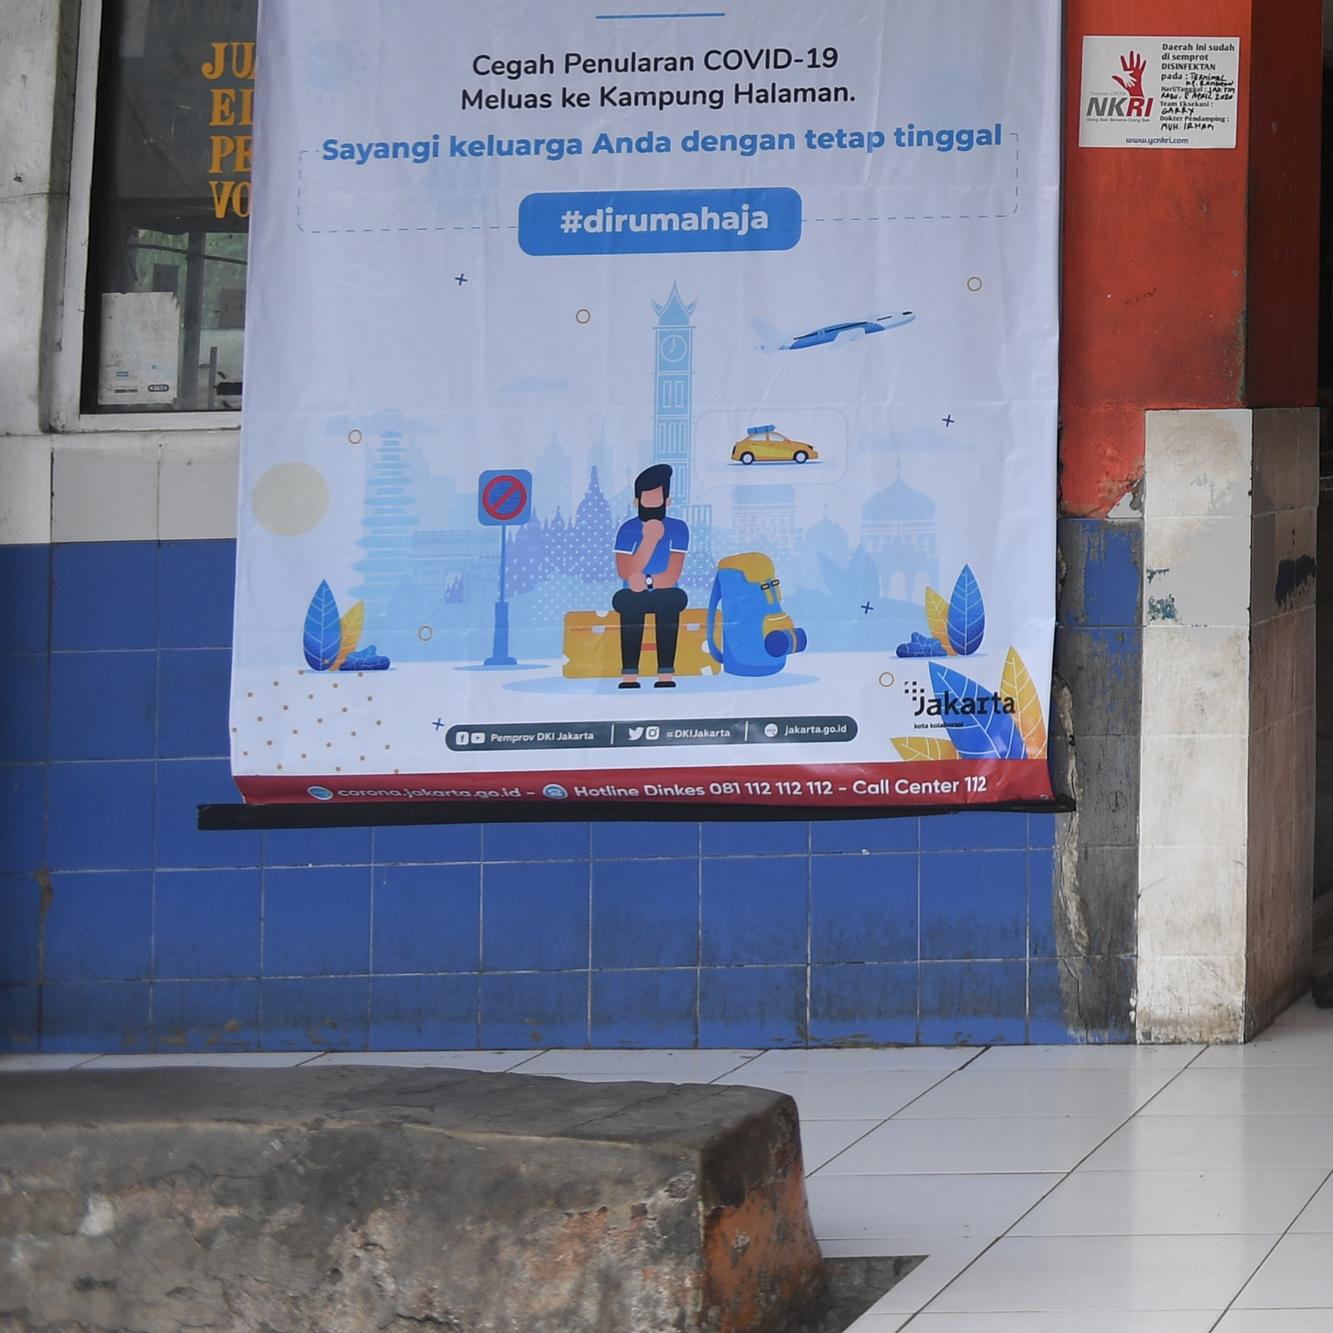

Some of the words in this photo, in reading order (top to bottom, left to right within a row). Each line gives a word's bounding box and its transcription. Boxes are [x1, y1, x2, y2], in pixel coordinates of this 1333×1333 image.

[202, 43, 256, 80] JU
[472, 53, 555, 79] Cegah
[565, 50, 694, 75] Penularan
[703, 46, 838, 71] COVID-19
[1172, 54, 1208, 62] semprot
[1161, 73, 1182, 81] pada
[461, 85, 553, 110] Meluas
[561, 84, 591, 108] ke
[600, 83, 724, 113] Kampung
[733, 80, 856, 106] Halaman.
[1087, 98, 1154, 116] NKRI
[321, 135, 440, 166] Sayangi
[449, 133, 583, 163] keluarga
[592, 131, 671, 155] Anda
[681, 128, 796, 159] dengan
[805, 125, 885, 153] tetap
[893, 123, 1002, 151] tinggal
[560, 206, 770, 236] #dirumahaja
[490, 733, 535, 744] Pemprov
[537, 732, 554, 741] DKI
[557, 731, 594, 740] Jakarta
[667, 728, 730, 739] @DKIJakarta
[784, 723, 847, 735] jakarta.go.id
[338, 787, 522, 799] corona.jakarta.go.id
[575, 786, 639, 797] Hotline
[644, 784, 705, 797] Dinkes
[710, 782, 740, 795] 081
[745, 782, 771, 795] 112
[776, 782, 802, 795] 112
[806, 781, 833, 794] 112
[853, 780, 889, 794] Call
[895, 779, 959, 793] Center
[964, 776, 986, 792] 112
